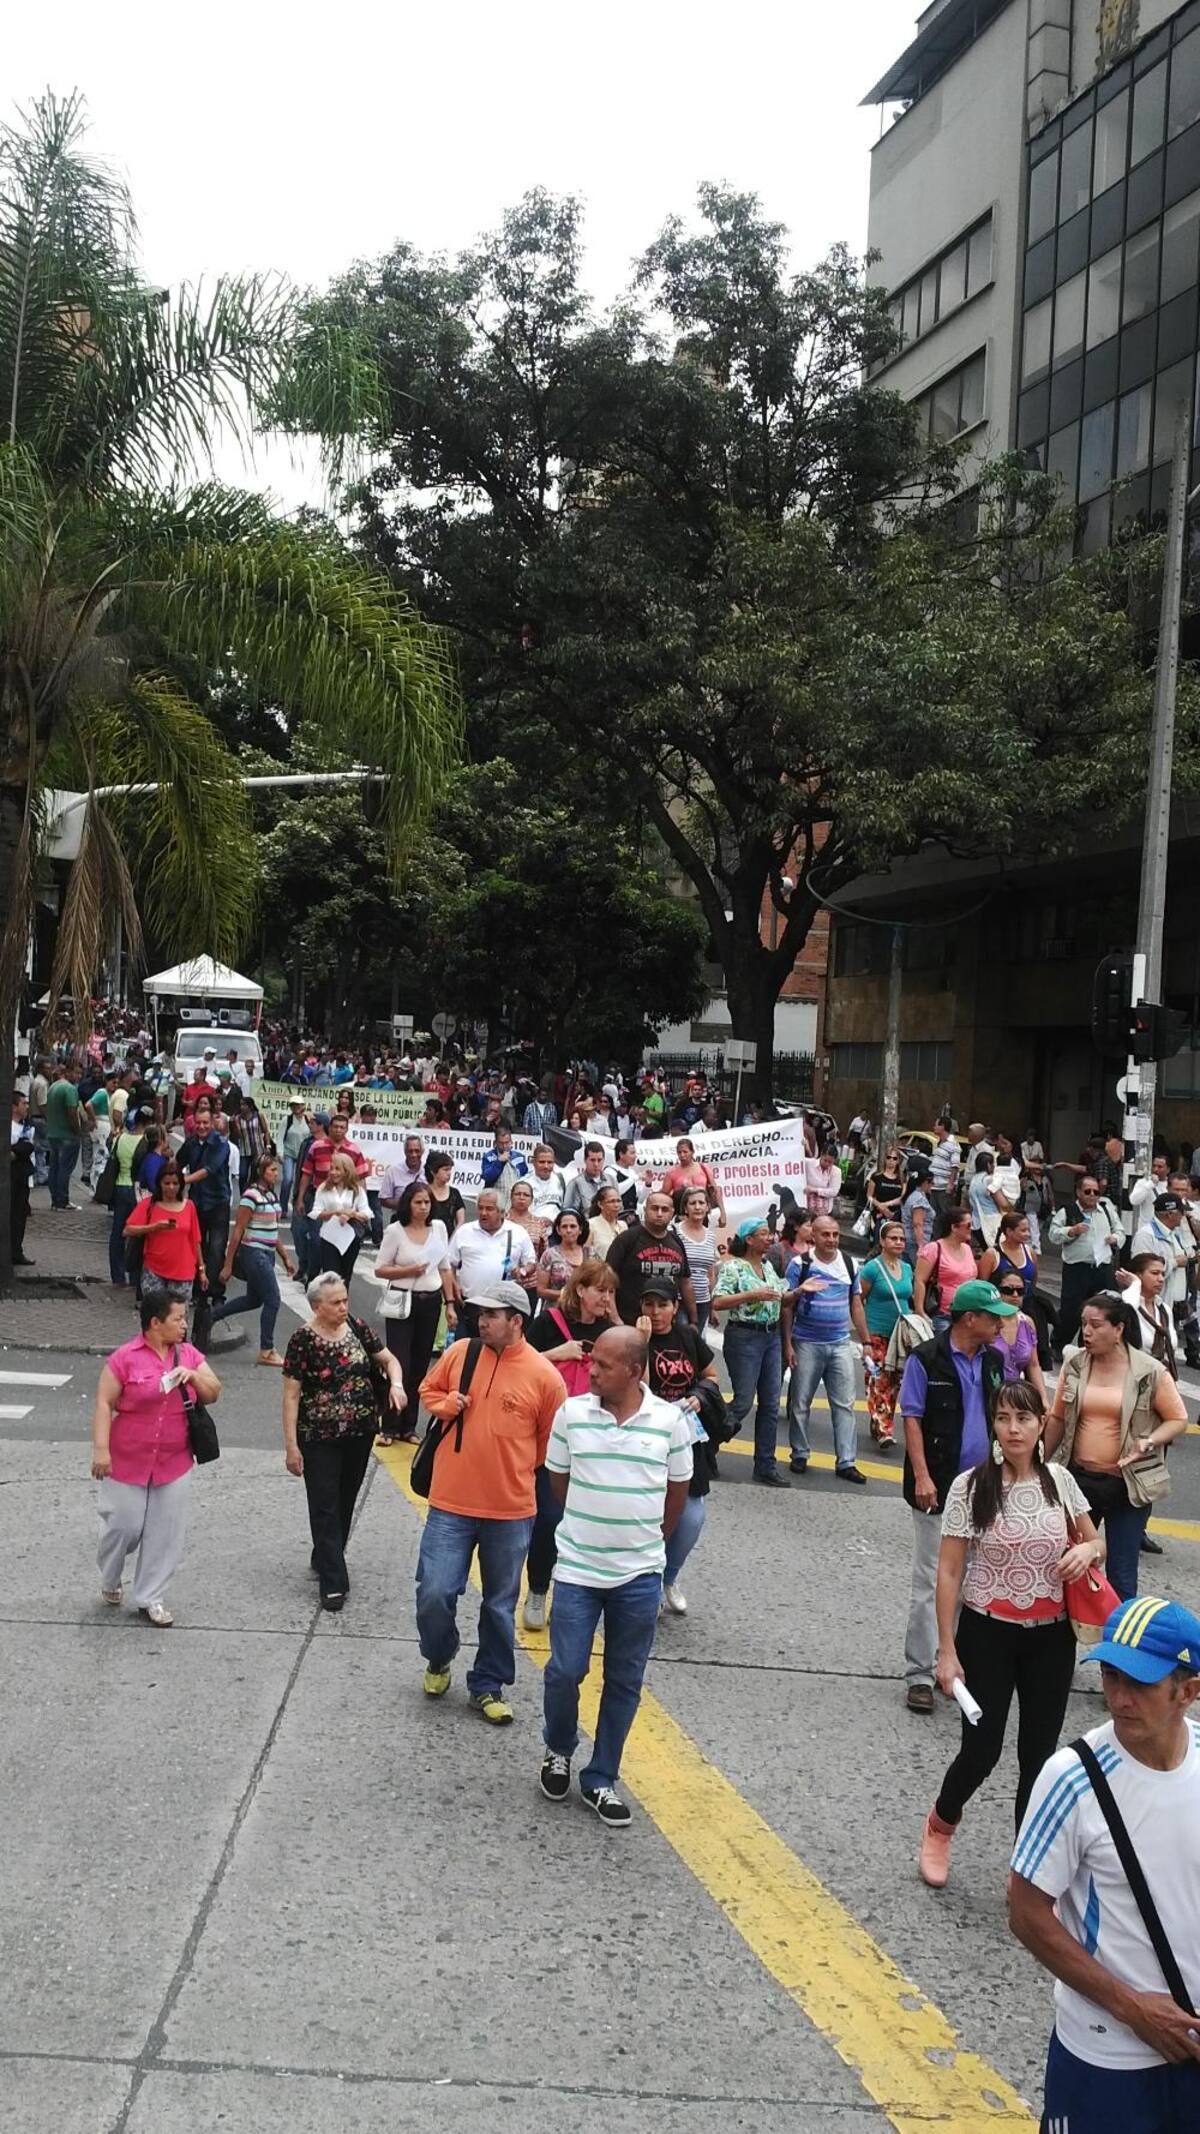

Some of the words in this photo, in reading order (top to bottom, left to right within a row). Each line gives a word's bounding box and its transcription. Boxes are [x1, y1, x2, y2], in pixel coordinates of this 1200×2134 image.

[262, 1098, 272, 1109] LA
[374, 1093, 384, 1104] LA
[387, 1094, 414, 1106] LUCHA
[352, 1130, 374, 1141] POR
[376, 1131, 389, 1142] LA
[441, 1136, 454, 1147] DE
[456, 1137, 469, 1148] LA
[452, 1170, 482, 1186] PARO
[724, 1161, 780, 1180] protesta
[784, 1161, 805, 1176] del
